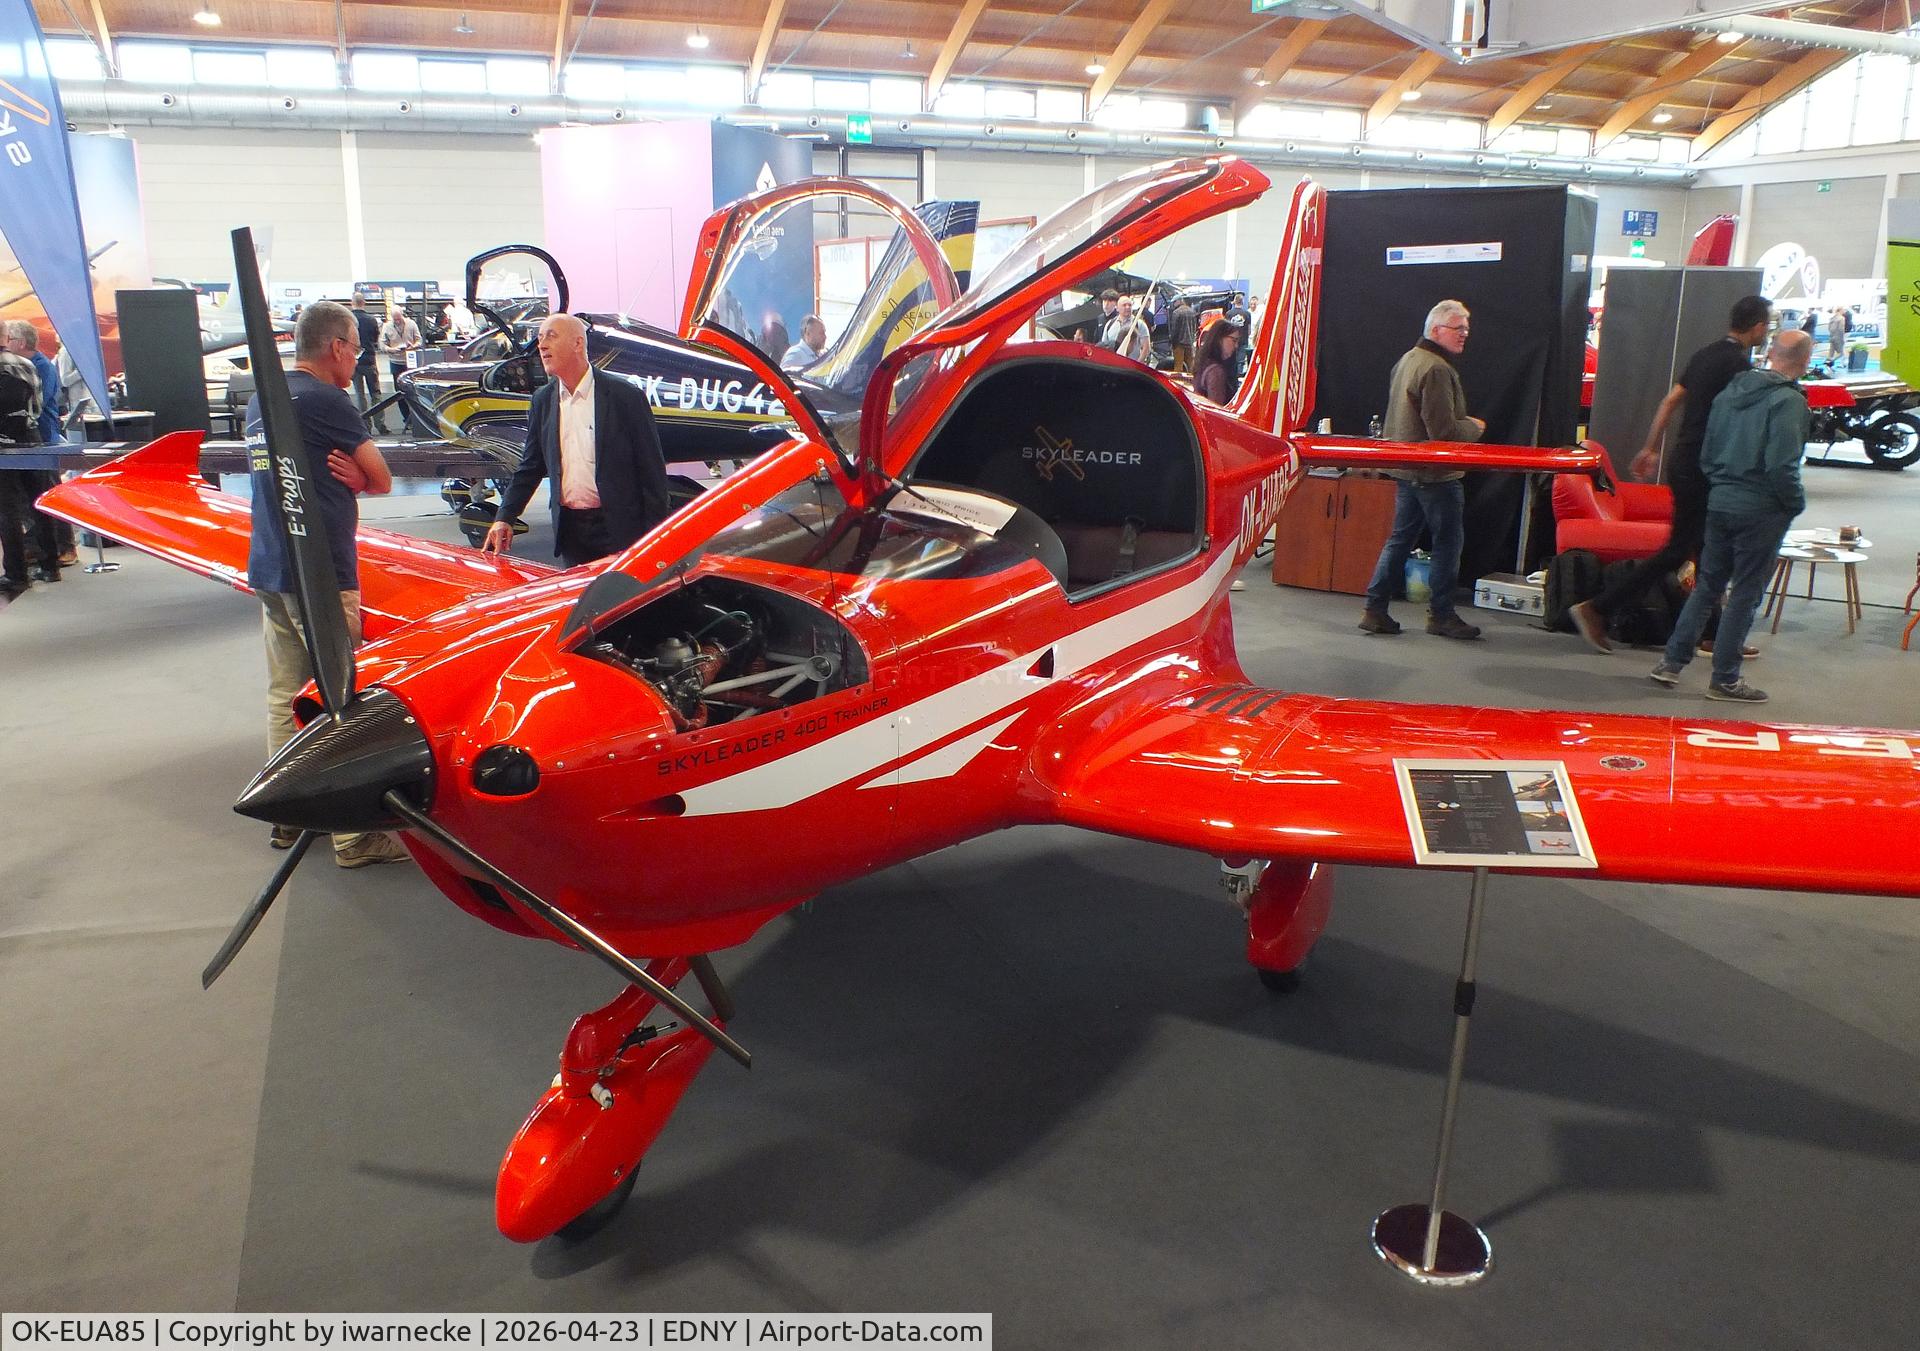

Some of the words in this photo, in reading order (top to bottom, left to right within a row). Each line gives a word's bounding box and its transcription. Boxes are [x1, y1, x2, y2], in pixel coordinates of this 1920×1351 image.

[1627, 211, 1639, 222] B1
[1022, 446, 1142, 465] SKYLEADER
[277, 455, 307, 536] E-Props
[657, 729, 786, 776] SKYLEADER
[793, 716, 828, 738] 400
